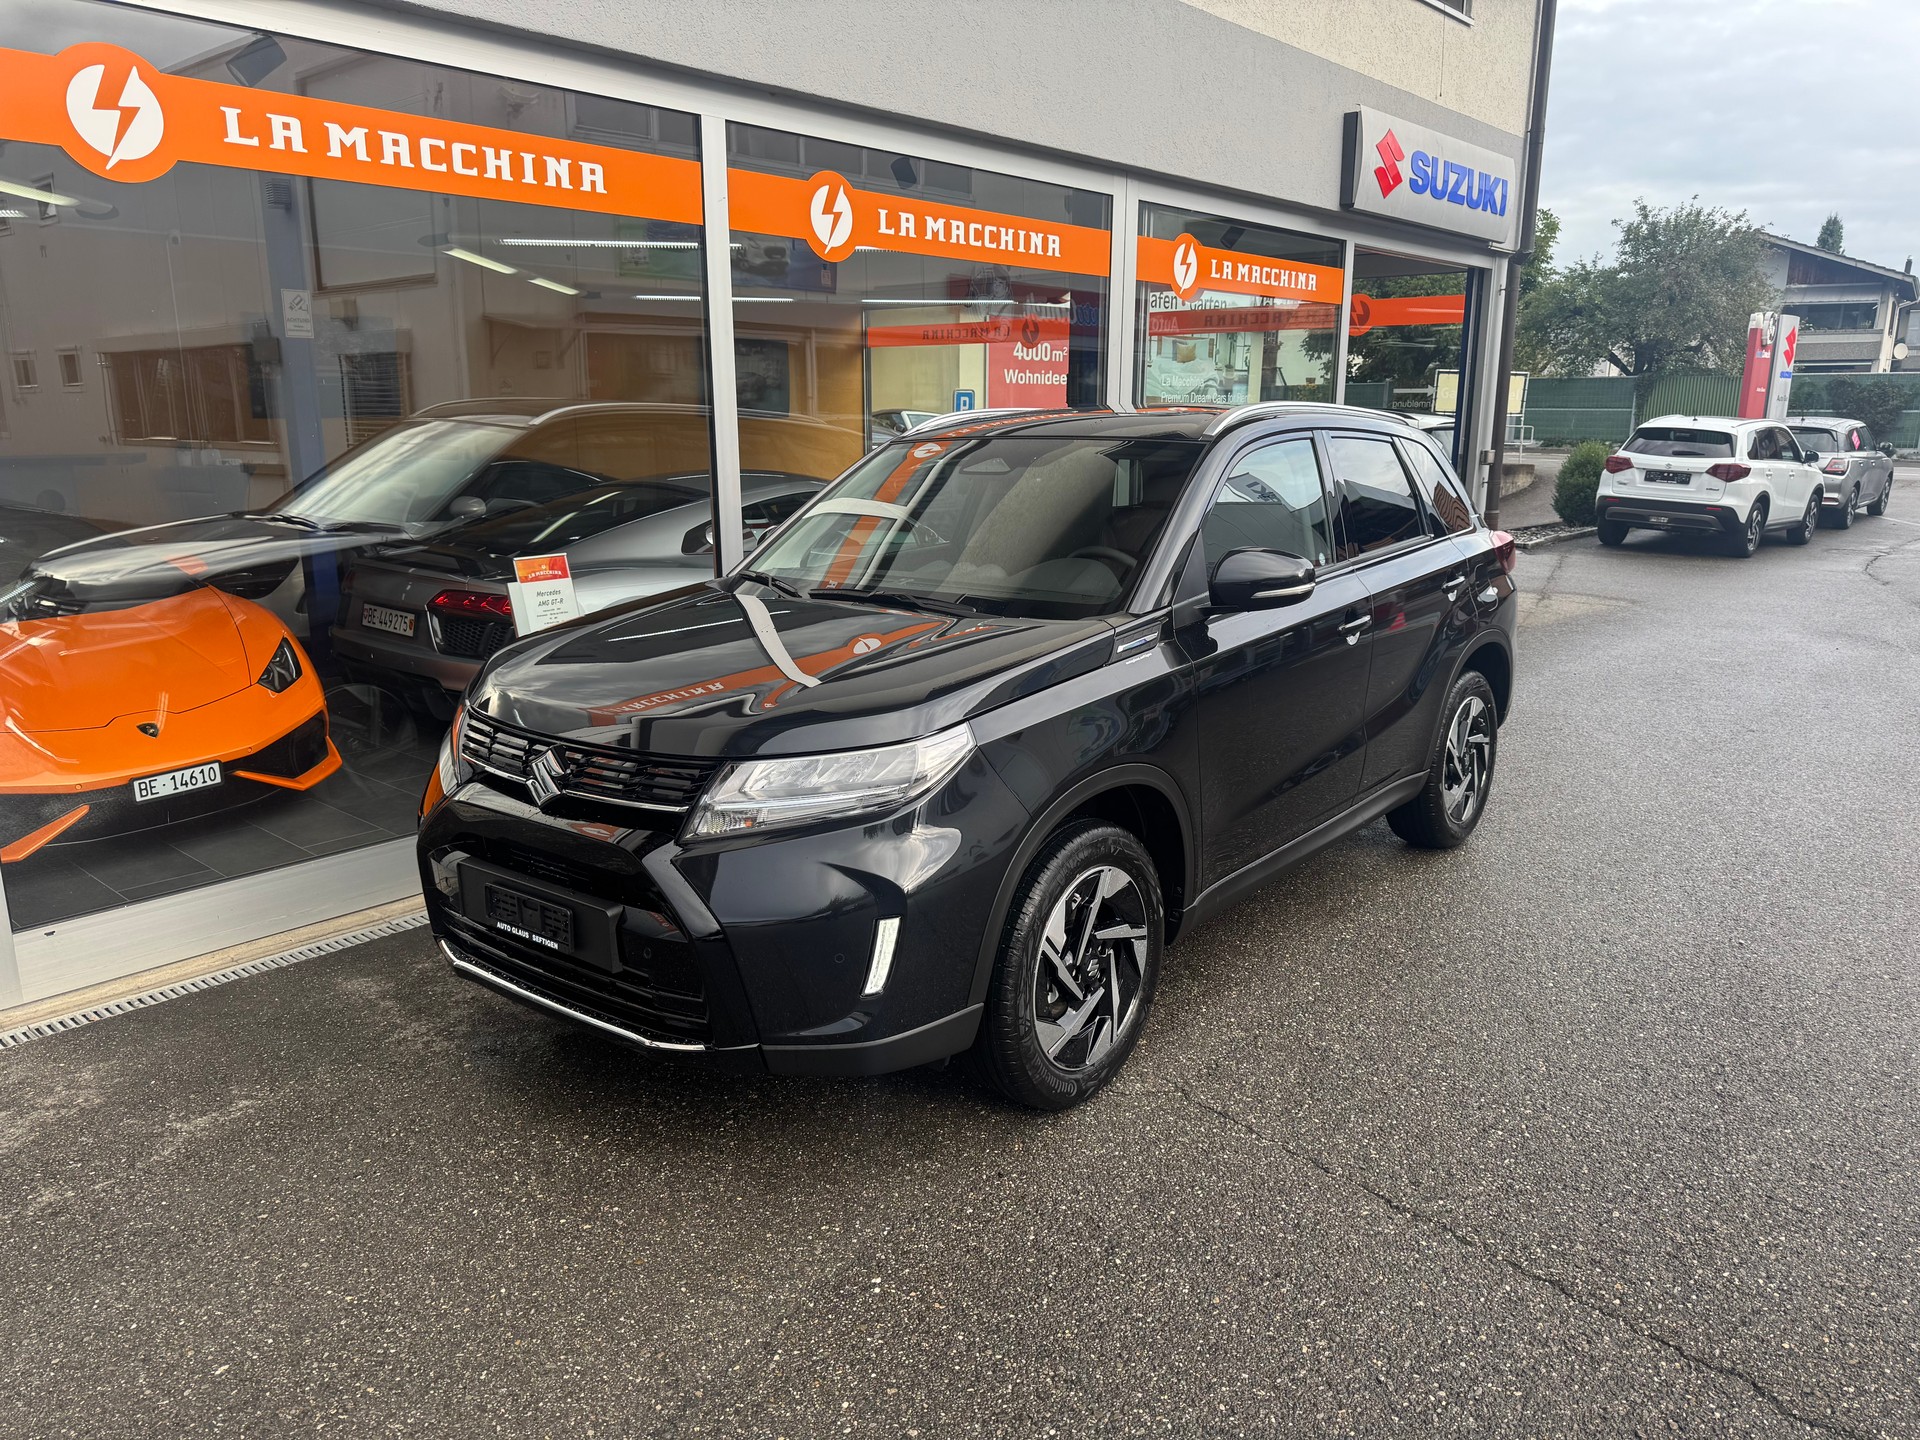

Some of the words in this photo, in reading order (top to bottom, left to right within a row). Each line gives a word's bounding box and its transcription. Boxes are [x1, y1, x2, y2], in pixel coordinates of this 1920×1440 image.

[220, 106, 307, 153] LA
[323, 122, 608, 195] MACCHINA
[1409, 149, 1509, 217] SUZUKI
[877, 208, 917, 238] LA
[924, 215, 1062, 258] MACCHINA
[1210, 258, 1233, 281] LA
[1236, 261, 1318, 292] MACCHINA
[1161, 375, 1171, 386] La
[1161, 391, 1190, 403] Premium
[1190, 392, 1212, 403] Dream
[1212, 392, 1227, 403] Cars
[536, 589, 561, 598] Mercedes
[496, 921, 511, 933] AUTO
[511, 926, 530, 939] GLAUS
[532, 934, 559, 950] SEFTIGEN
